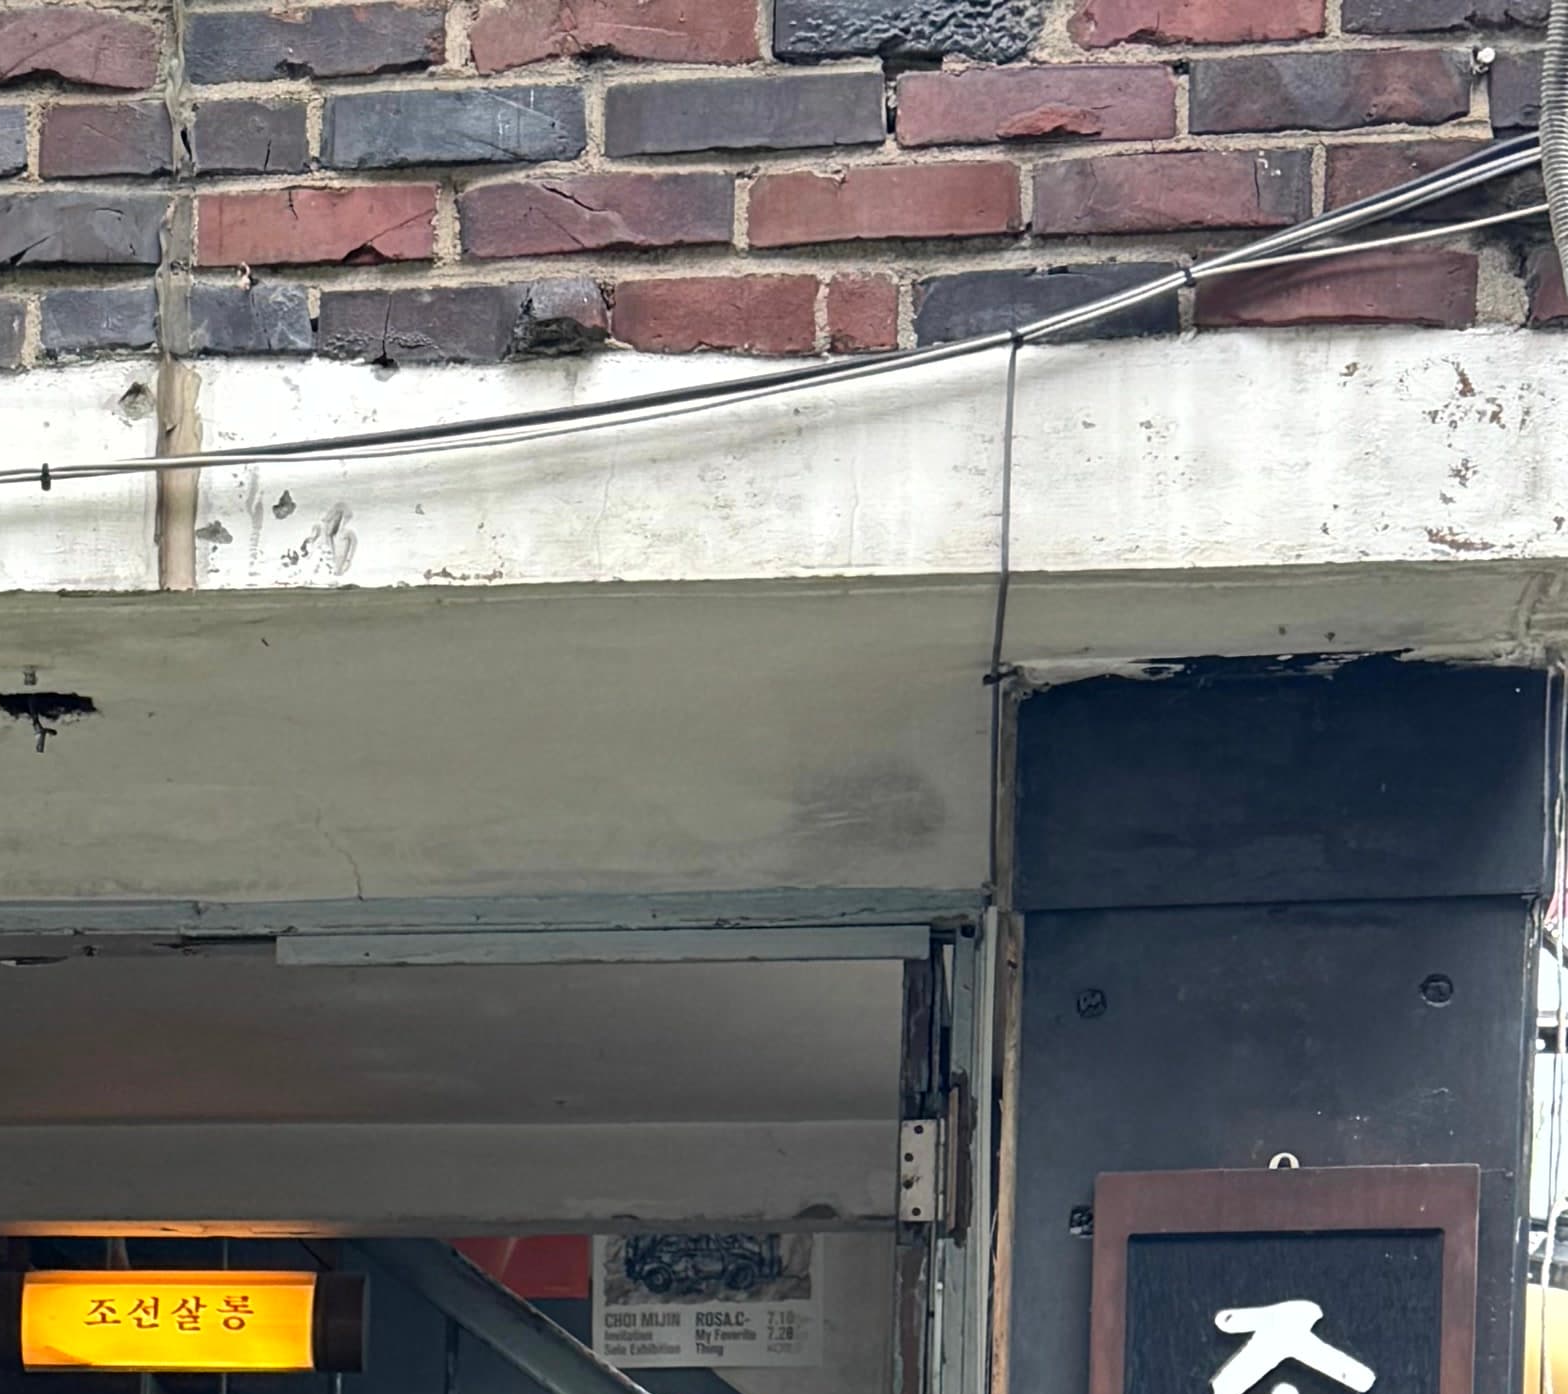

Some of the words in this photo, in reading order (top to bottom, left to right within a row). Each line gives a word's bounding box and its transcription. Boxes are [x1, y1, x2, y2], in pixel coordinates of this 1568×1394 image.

[83, 1294, 255, 1332] 조선살롱
[604, 1313, 637, 1328] CHOI
[640, 1312, 681, 1327] MIJIN
